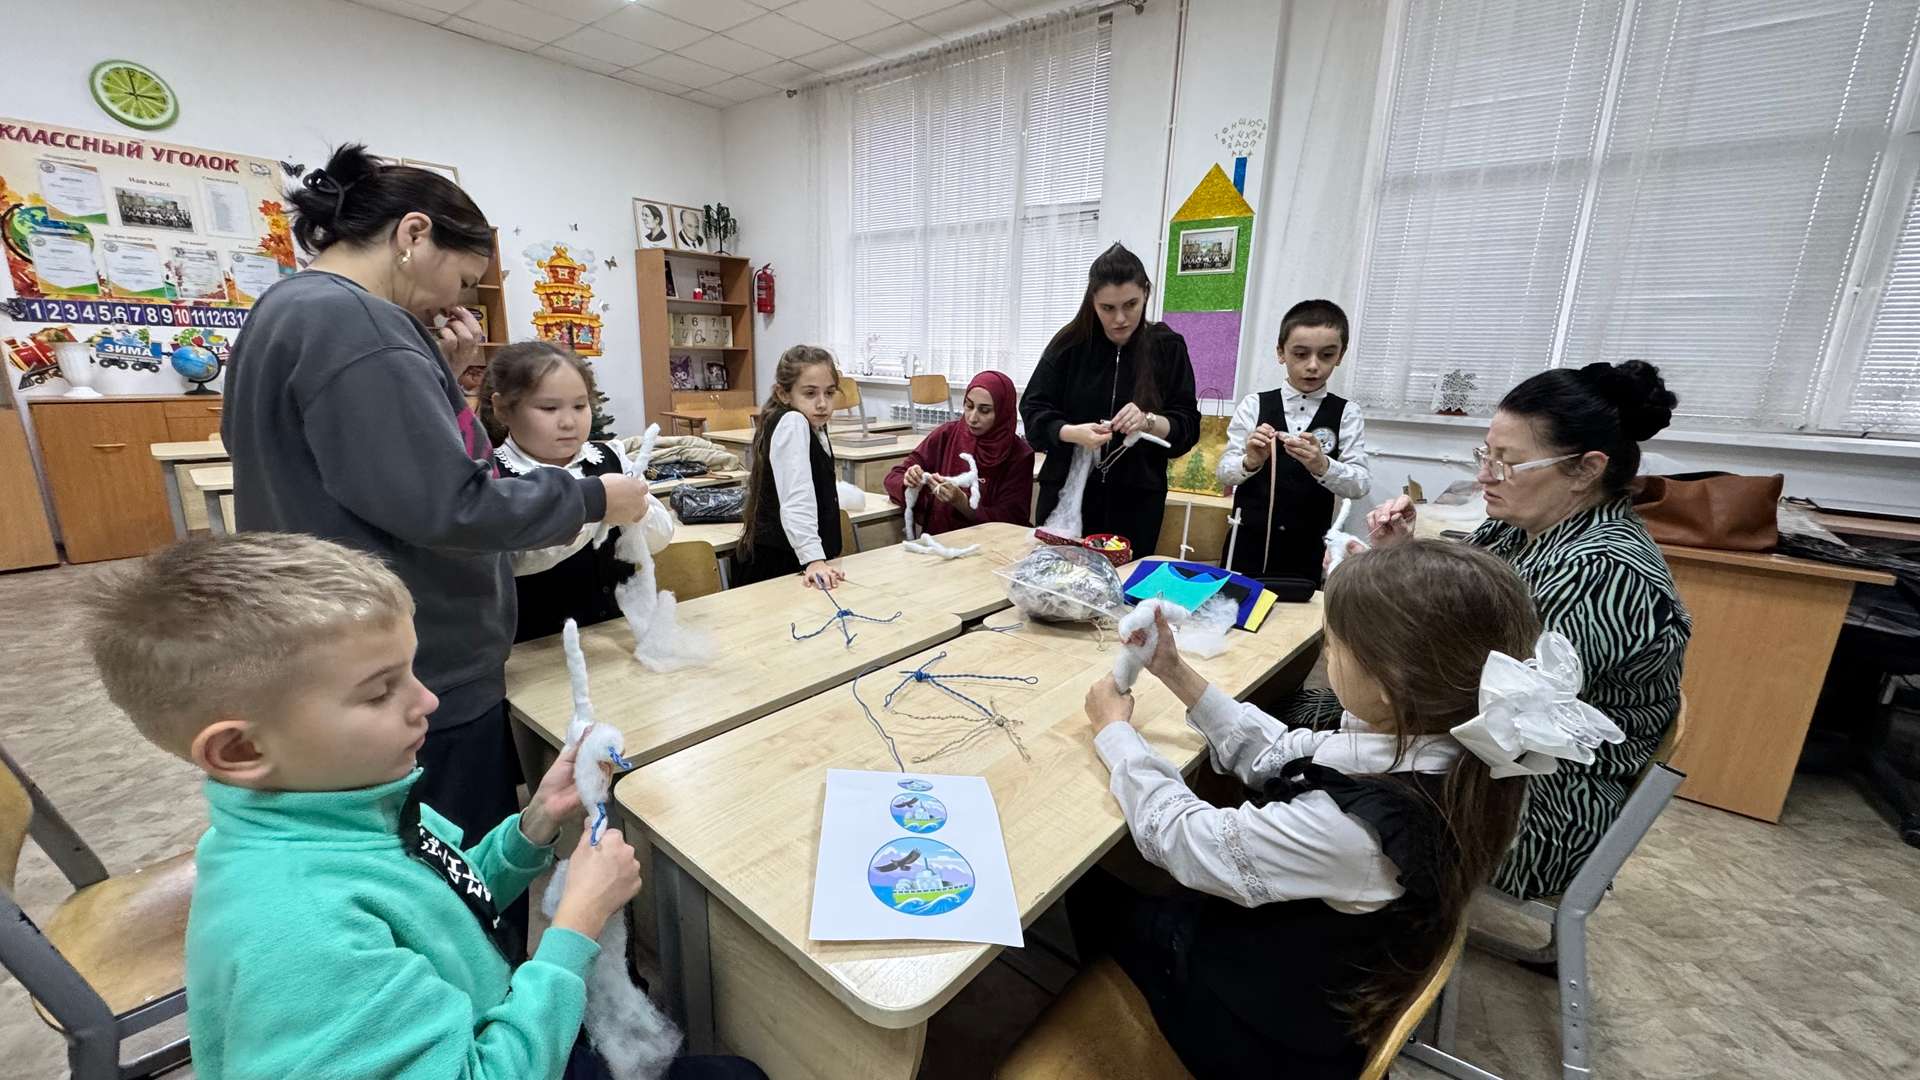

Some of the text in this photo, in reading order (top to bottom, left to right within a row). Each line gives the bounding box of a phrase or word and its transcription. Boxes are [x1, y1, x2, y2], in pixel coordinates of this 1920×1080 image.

[0, 123, 240, 174] КЛАССНЫЙ УГОЛОК
[31, 303, 42, 319] 1
[47, 303, 62, 320] 2
[64, 303, 78, 320] 3
[83, 304, 95, 321] 4
[99, 305, 111, 321] 5
[115, 306, 128, 321] 6
[130, 306, 141, 322] 7
[146, 307, 158, 323] 8
[161, 308, 173, 323] 9
[175, 308, 190, 324] 10
[192, 310, 206, 325] 11
[207, 310, 222, 325] 12
[222, 311, 236, 326] 13
[104, 343, 152, 357] ЗИМА
